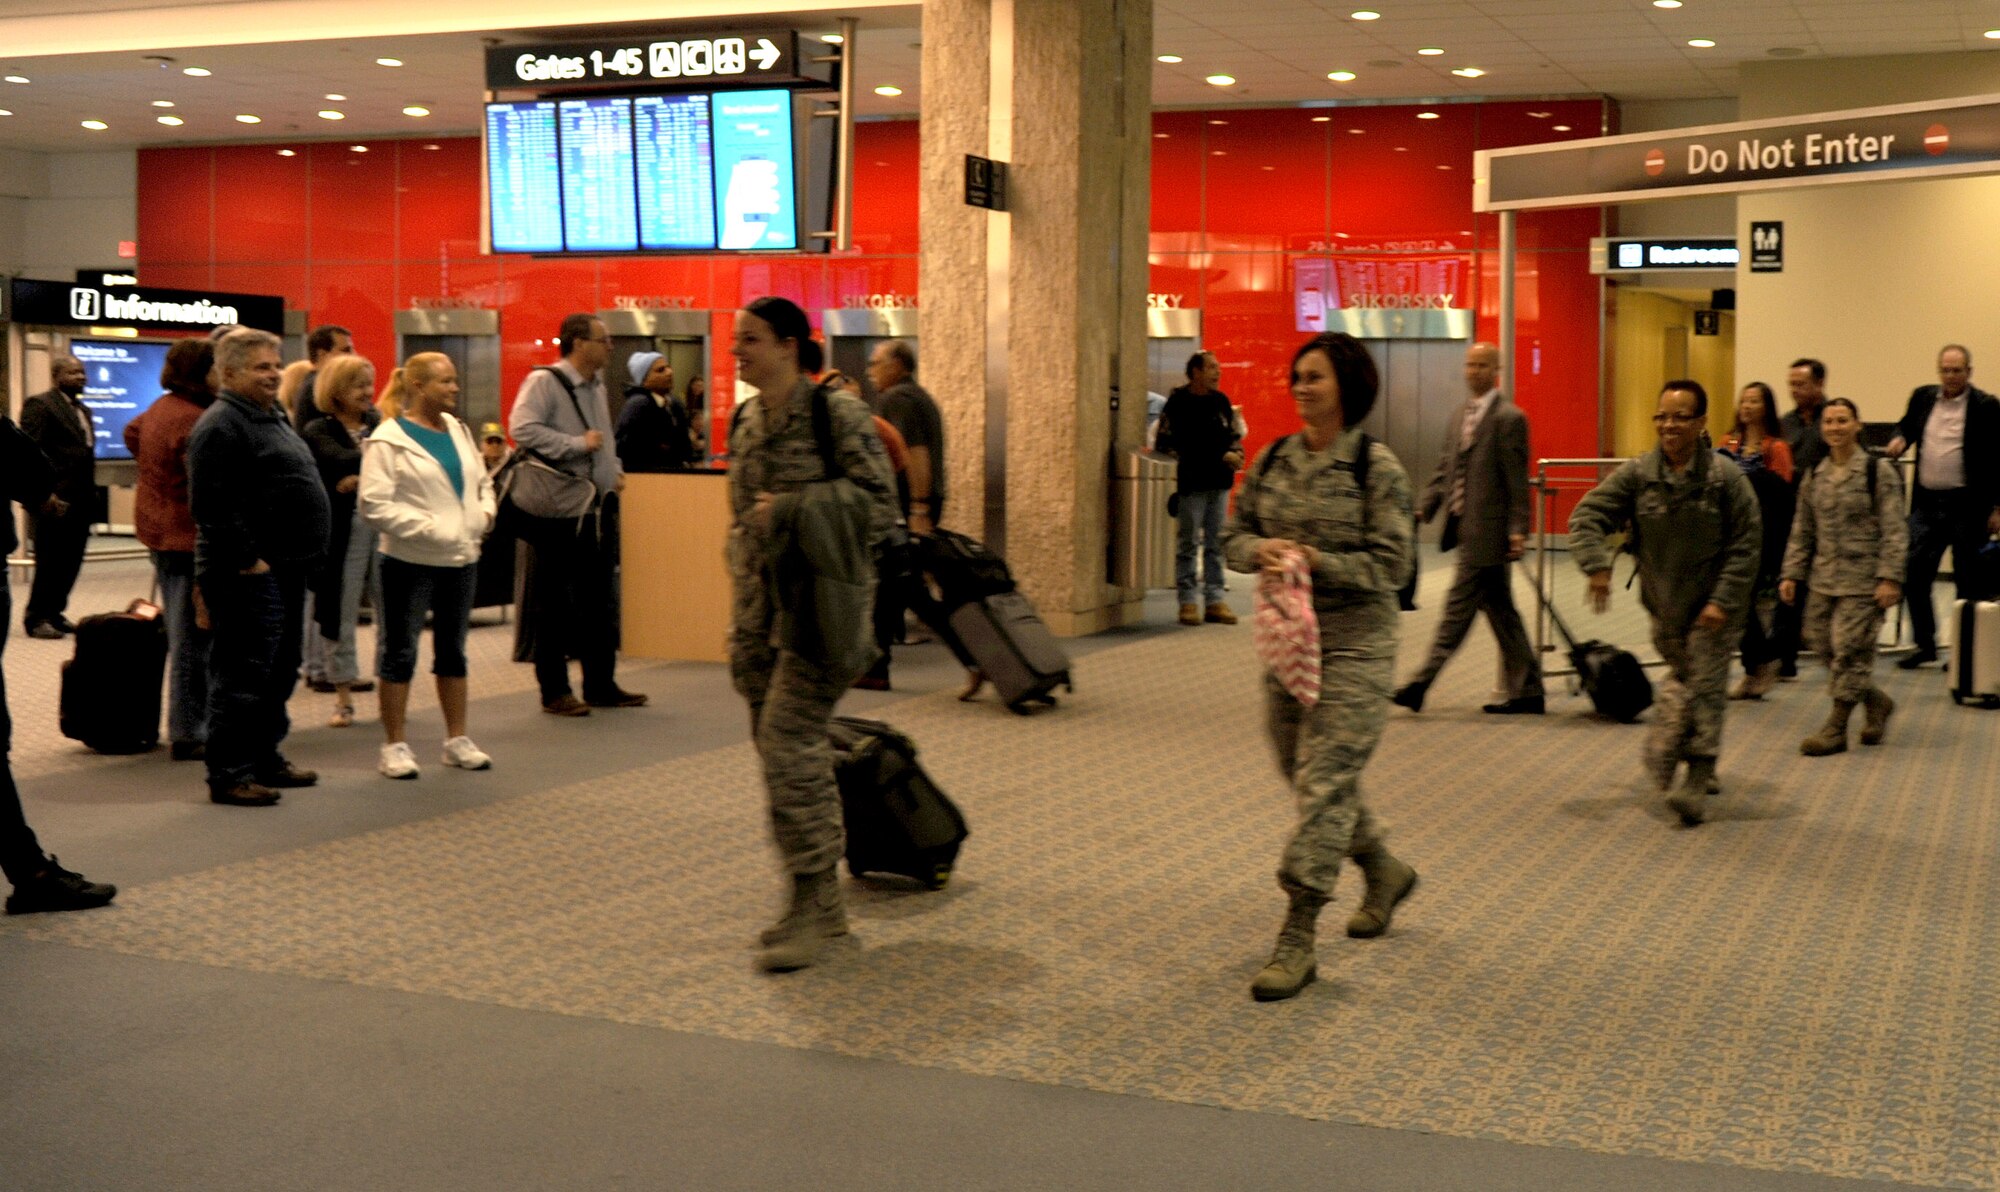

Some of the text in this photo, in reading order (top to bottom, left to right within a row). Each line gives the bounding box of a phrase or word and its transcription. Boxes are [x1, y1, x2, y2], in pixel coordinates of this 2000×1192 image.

[515, 53, 586, 81] Gates
[590, 47, 643, 77] 1-45
[1687, 132, 1896, 175] Do Not Enter
[104, 293, 239, 325] Information
[842, 293, 919, 310] SIKORSK
[1350, 293, 1454, 310] SIKORSKY
